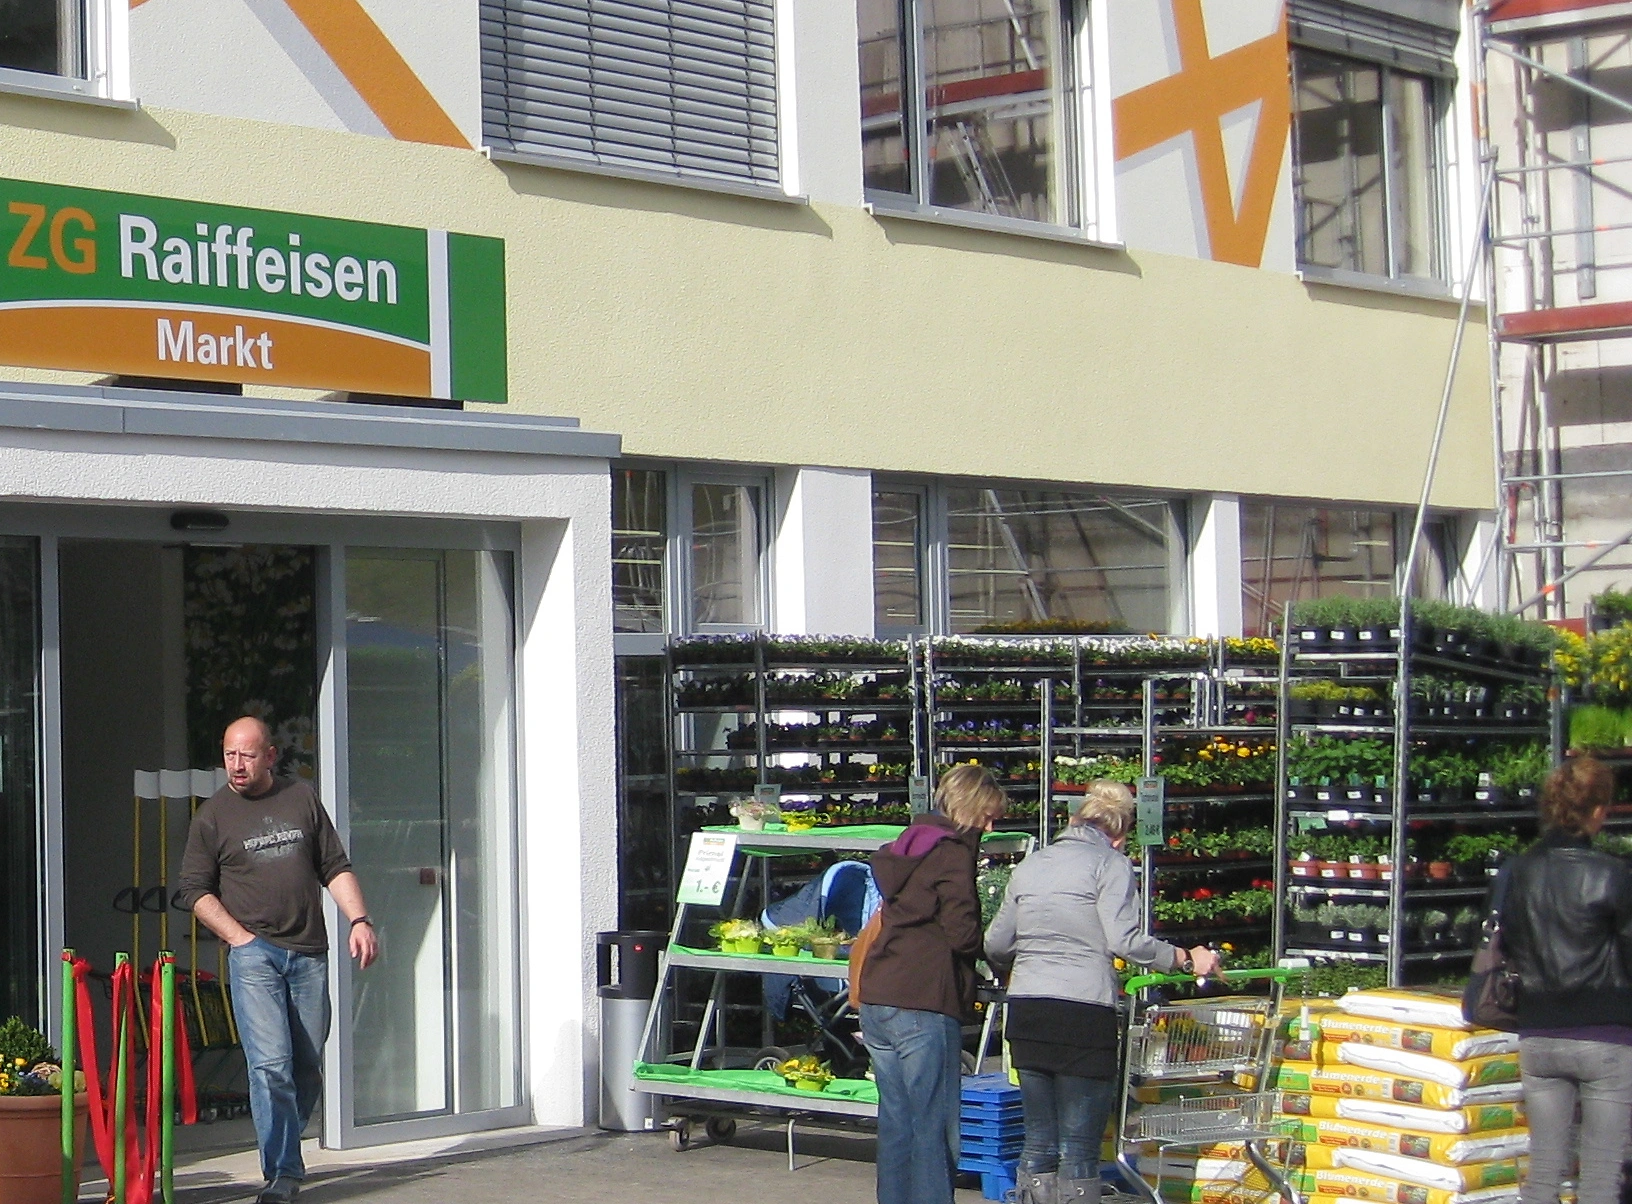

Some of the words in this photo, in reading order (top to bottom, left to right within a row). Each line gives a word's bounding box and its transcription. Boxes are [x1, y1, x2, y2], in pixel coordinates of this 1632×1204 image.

[8, 201, 97, 275] ZG
[119, 213, 398, 305] Raiffeisen
[156, 318, 274, 370] Markt
